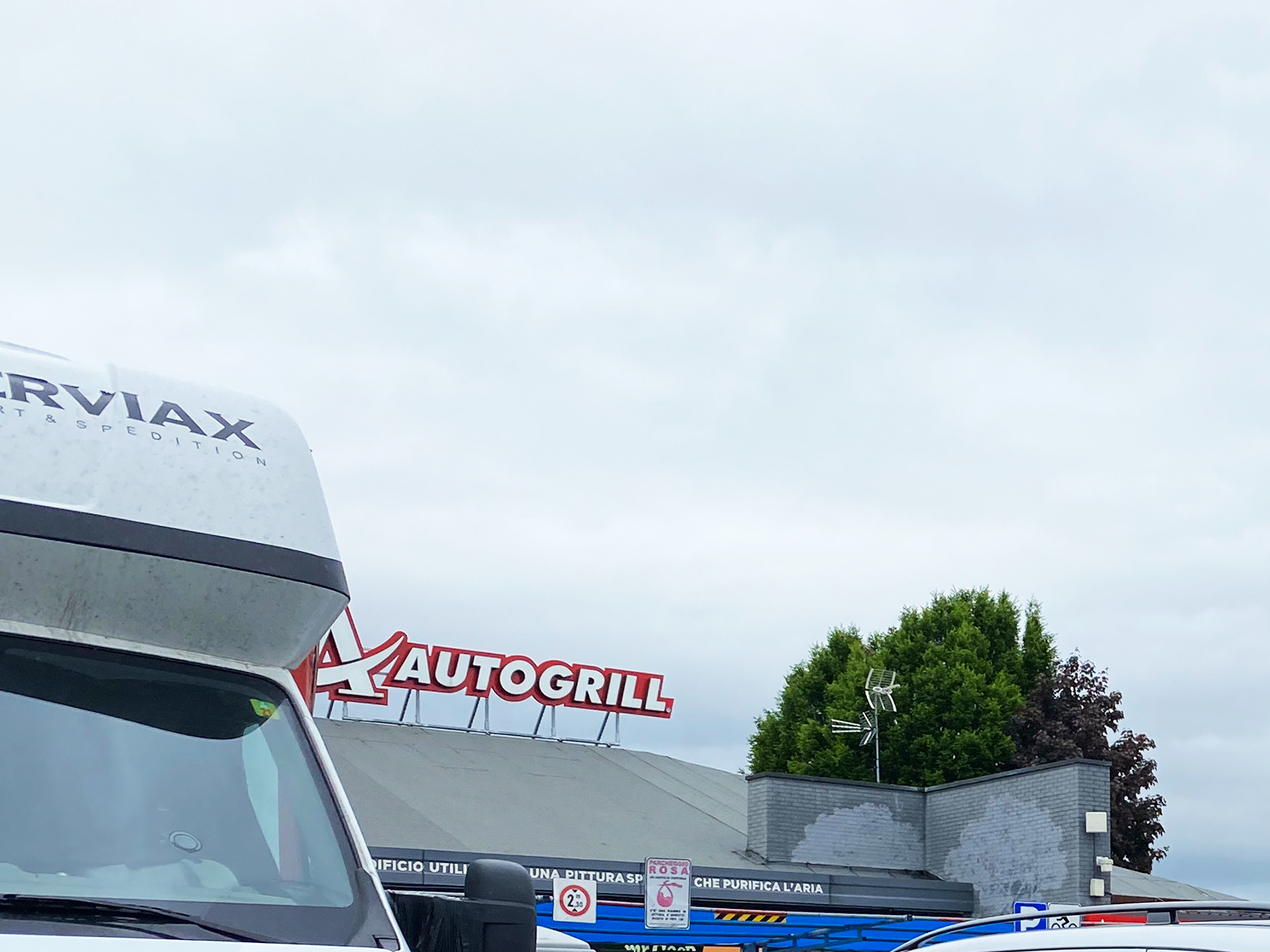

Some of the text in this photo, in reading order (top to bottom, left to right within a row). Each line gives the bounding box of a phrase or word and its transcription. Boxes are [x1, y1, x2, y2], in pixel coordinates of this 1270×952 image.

[0, 371, 261, 451] RVIAX
[46, 414, 57, 424] &
[76, 420, 267, 467] SPEDITION
[394, 647, 669, 713] AUTOGRILL
[429, 862, 470, 875] UTILI
[529, 867, 560, 880] UNA
[565, 869, 625, 884] PITTURA
[626, 873, 644, 885] SP
[694, 877, 721, 889] CHE
[723, 879, 781, 892] PURIFICA
[784, 882, 824, 894] L'ARIA
[649, 865, 689, 876] ROSA
